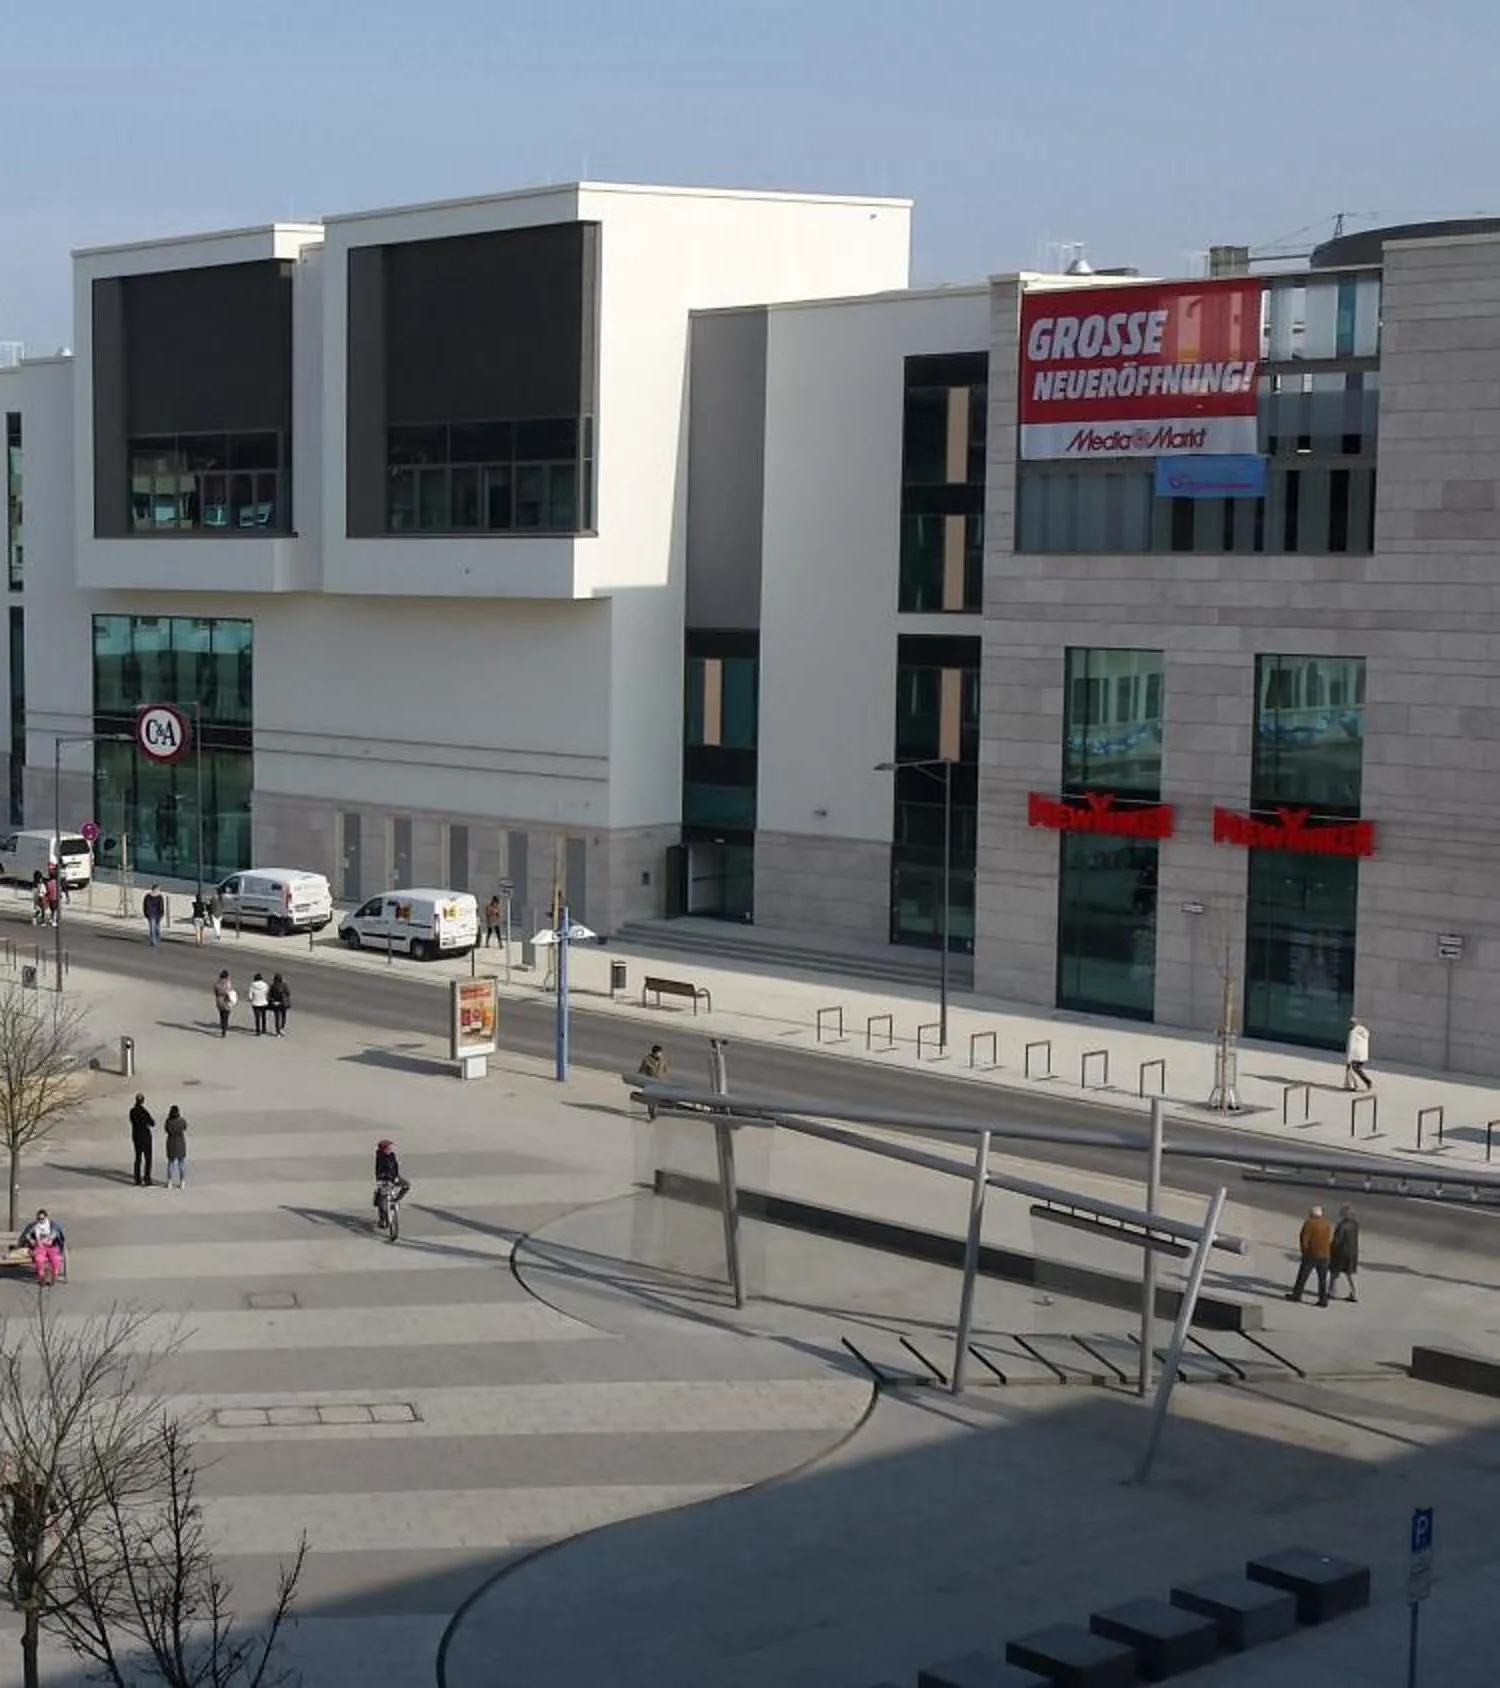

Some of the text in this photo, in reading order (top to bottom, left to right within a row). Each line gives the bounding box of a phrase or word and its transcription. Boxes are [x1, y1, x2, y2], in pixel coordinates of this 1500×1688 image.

[1028, 310, 1168, 360] GROSSE
[1033, 361, 1257, 400] NEUERÖFFNUNG!
[1066, 427, 1132, 452] Media
[145, 719, 177, 746] C&A
[1416, 1514, 1429, 1547] P
